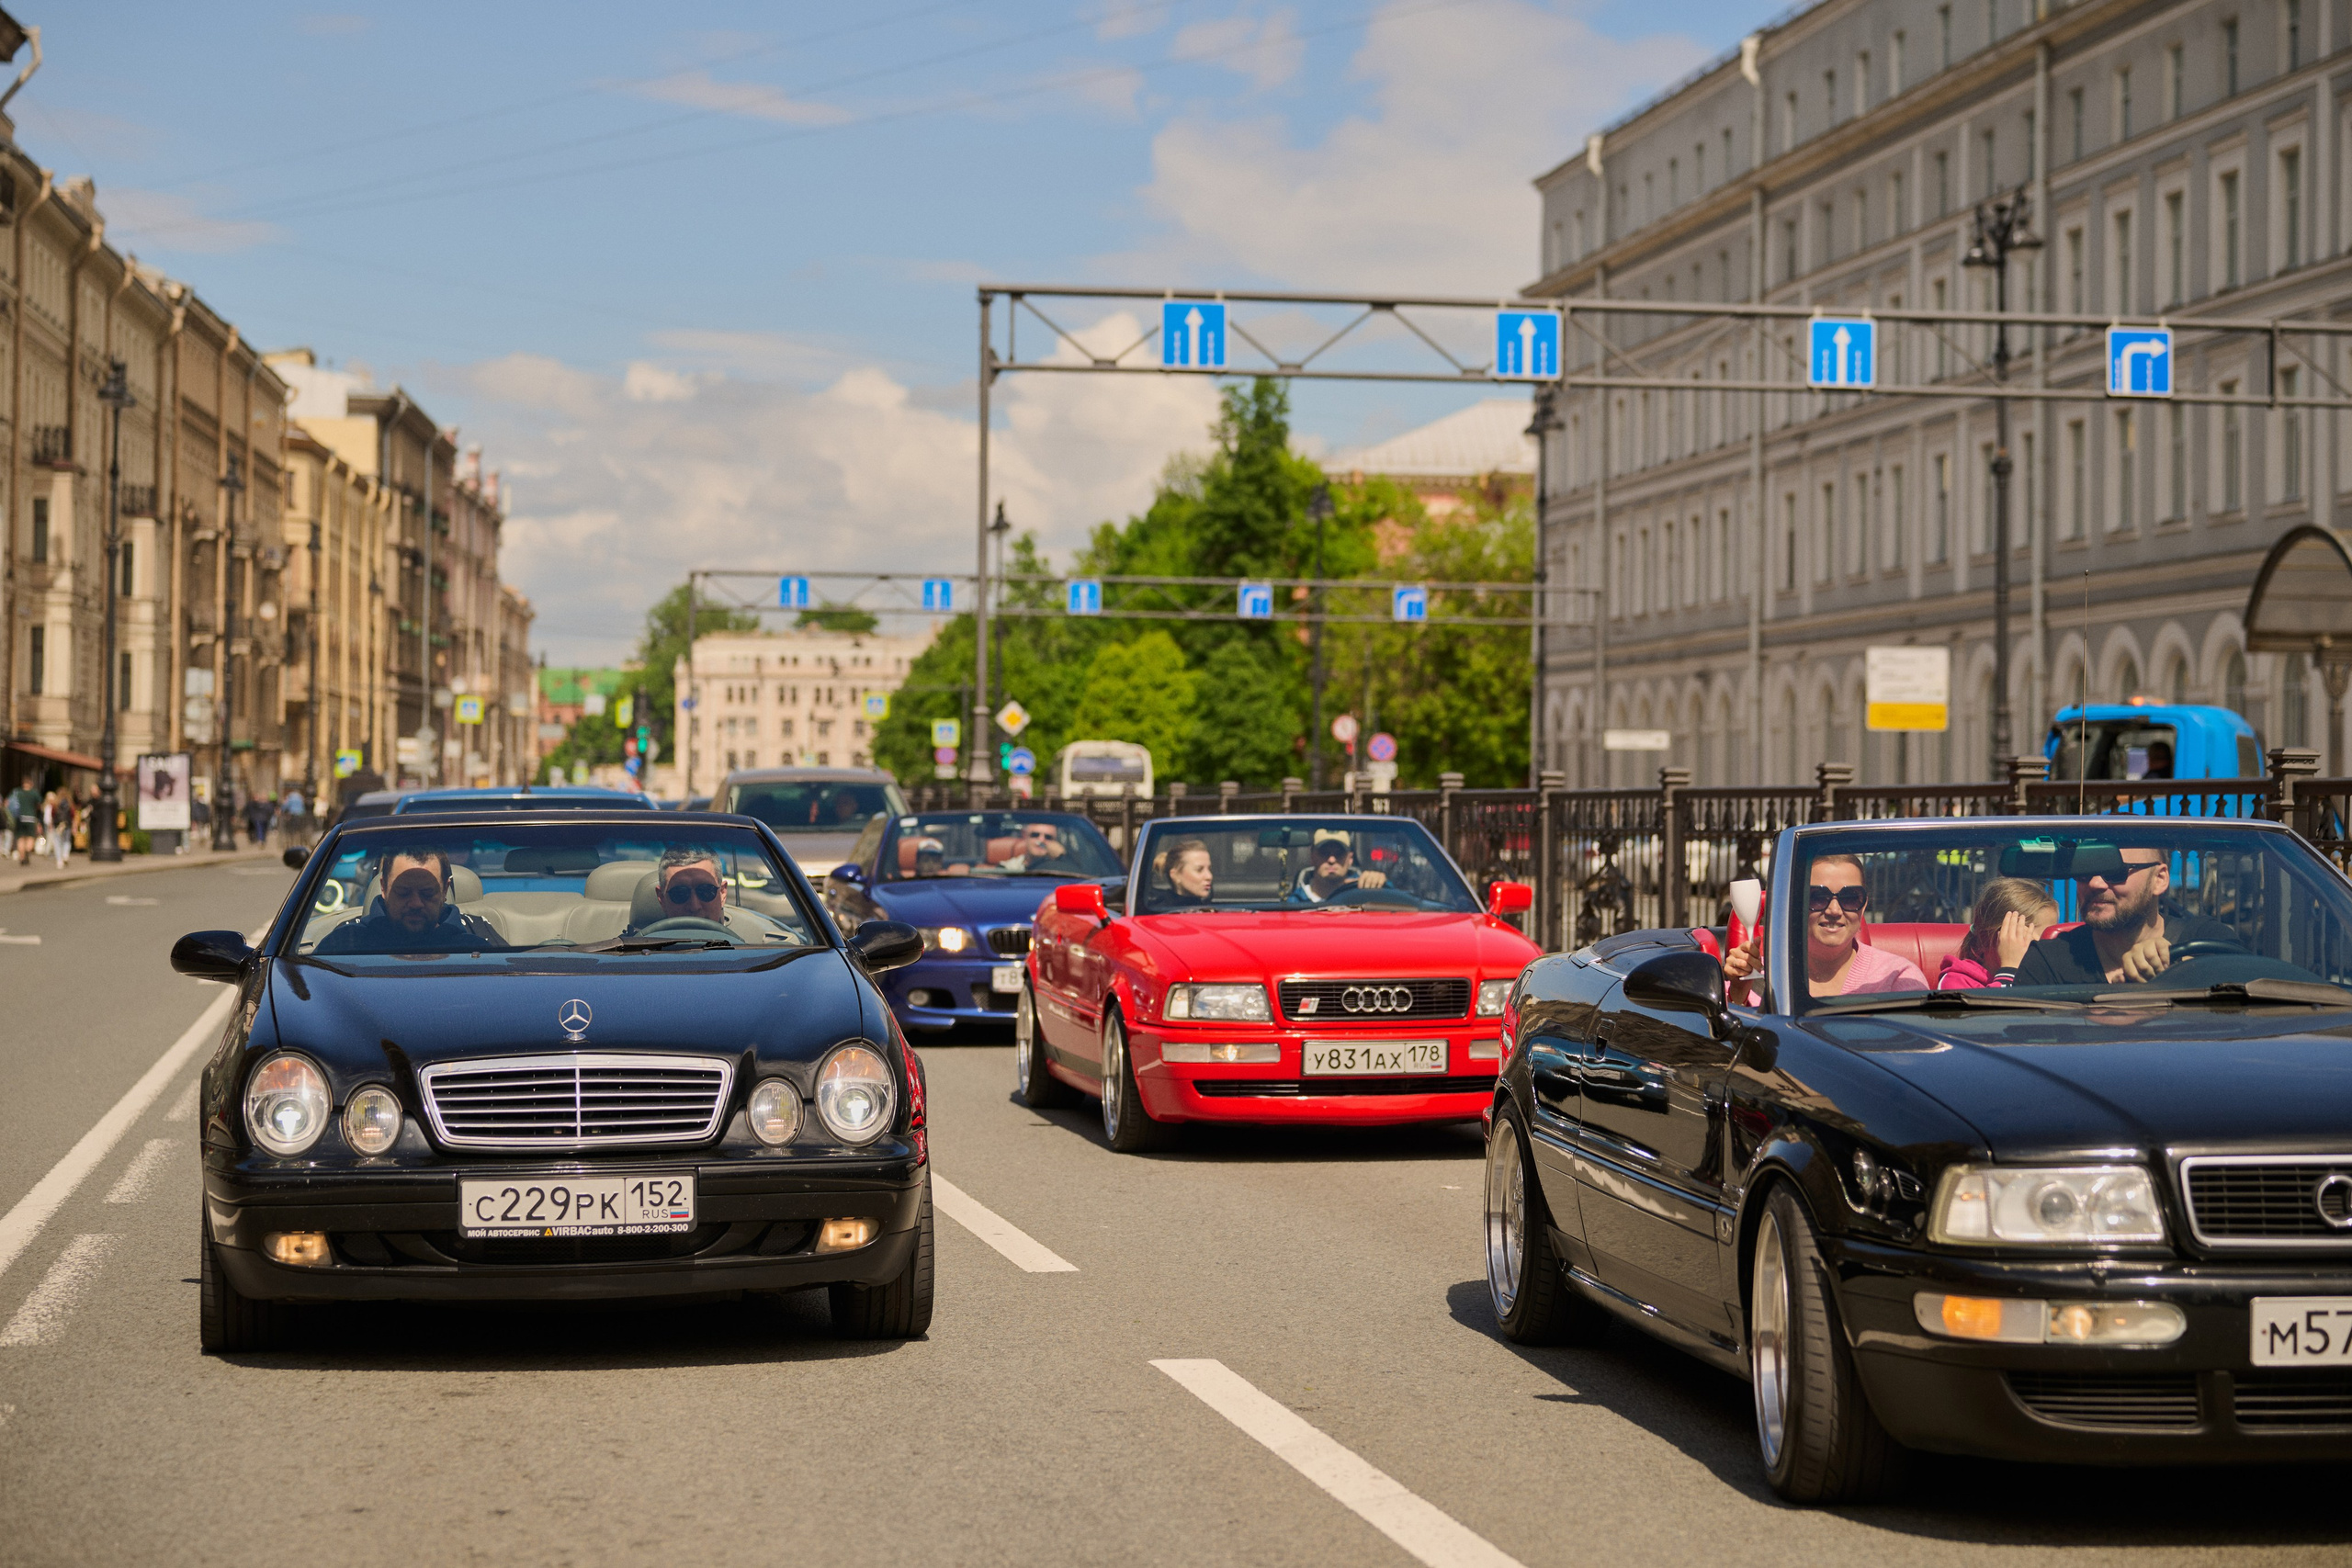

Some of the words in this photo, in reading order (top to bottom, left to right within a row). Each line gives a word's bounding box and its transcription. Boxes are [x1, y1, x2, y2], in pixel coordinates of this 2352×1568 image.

[1314, 1048, 1402, 1070] У831АХ
[1408, 1045, 1440, 1062] 178
[475, 1186, 619, 1223] С229РК
[630, 1180, 683, 1207] 152
[642, 1208, 669, 1219] RUS
[468, 1228, 487, 1237] МОЙ
[488, 1228, 540, 1237] АВТОСЕРВИС
[552, 1225, 614, 1236] VIRBACauto
[617, 1223, 688, 1235] 8-800-2-200-300
